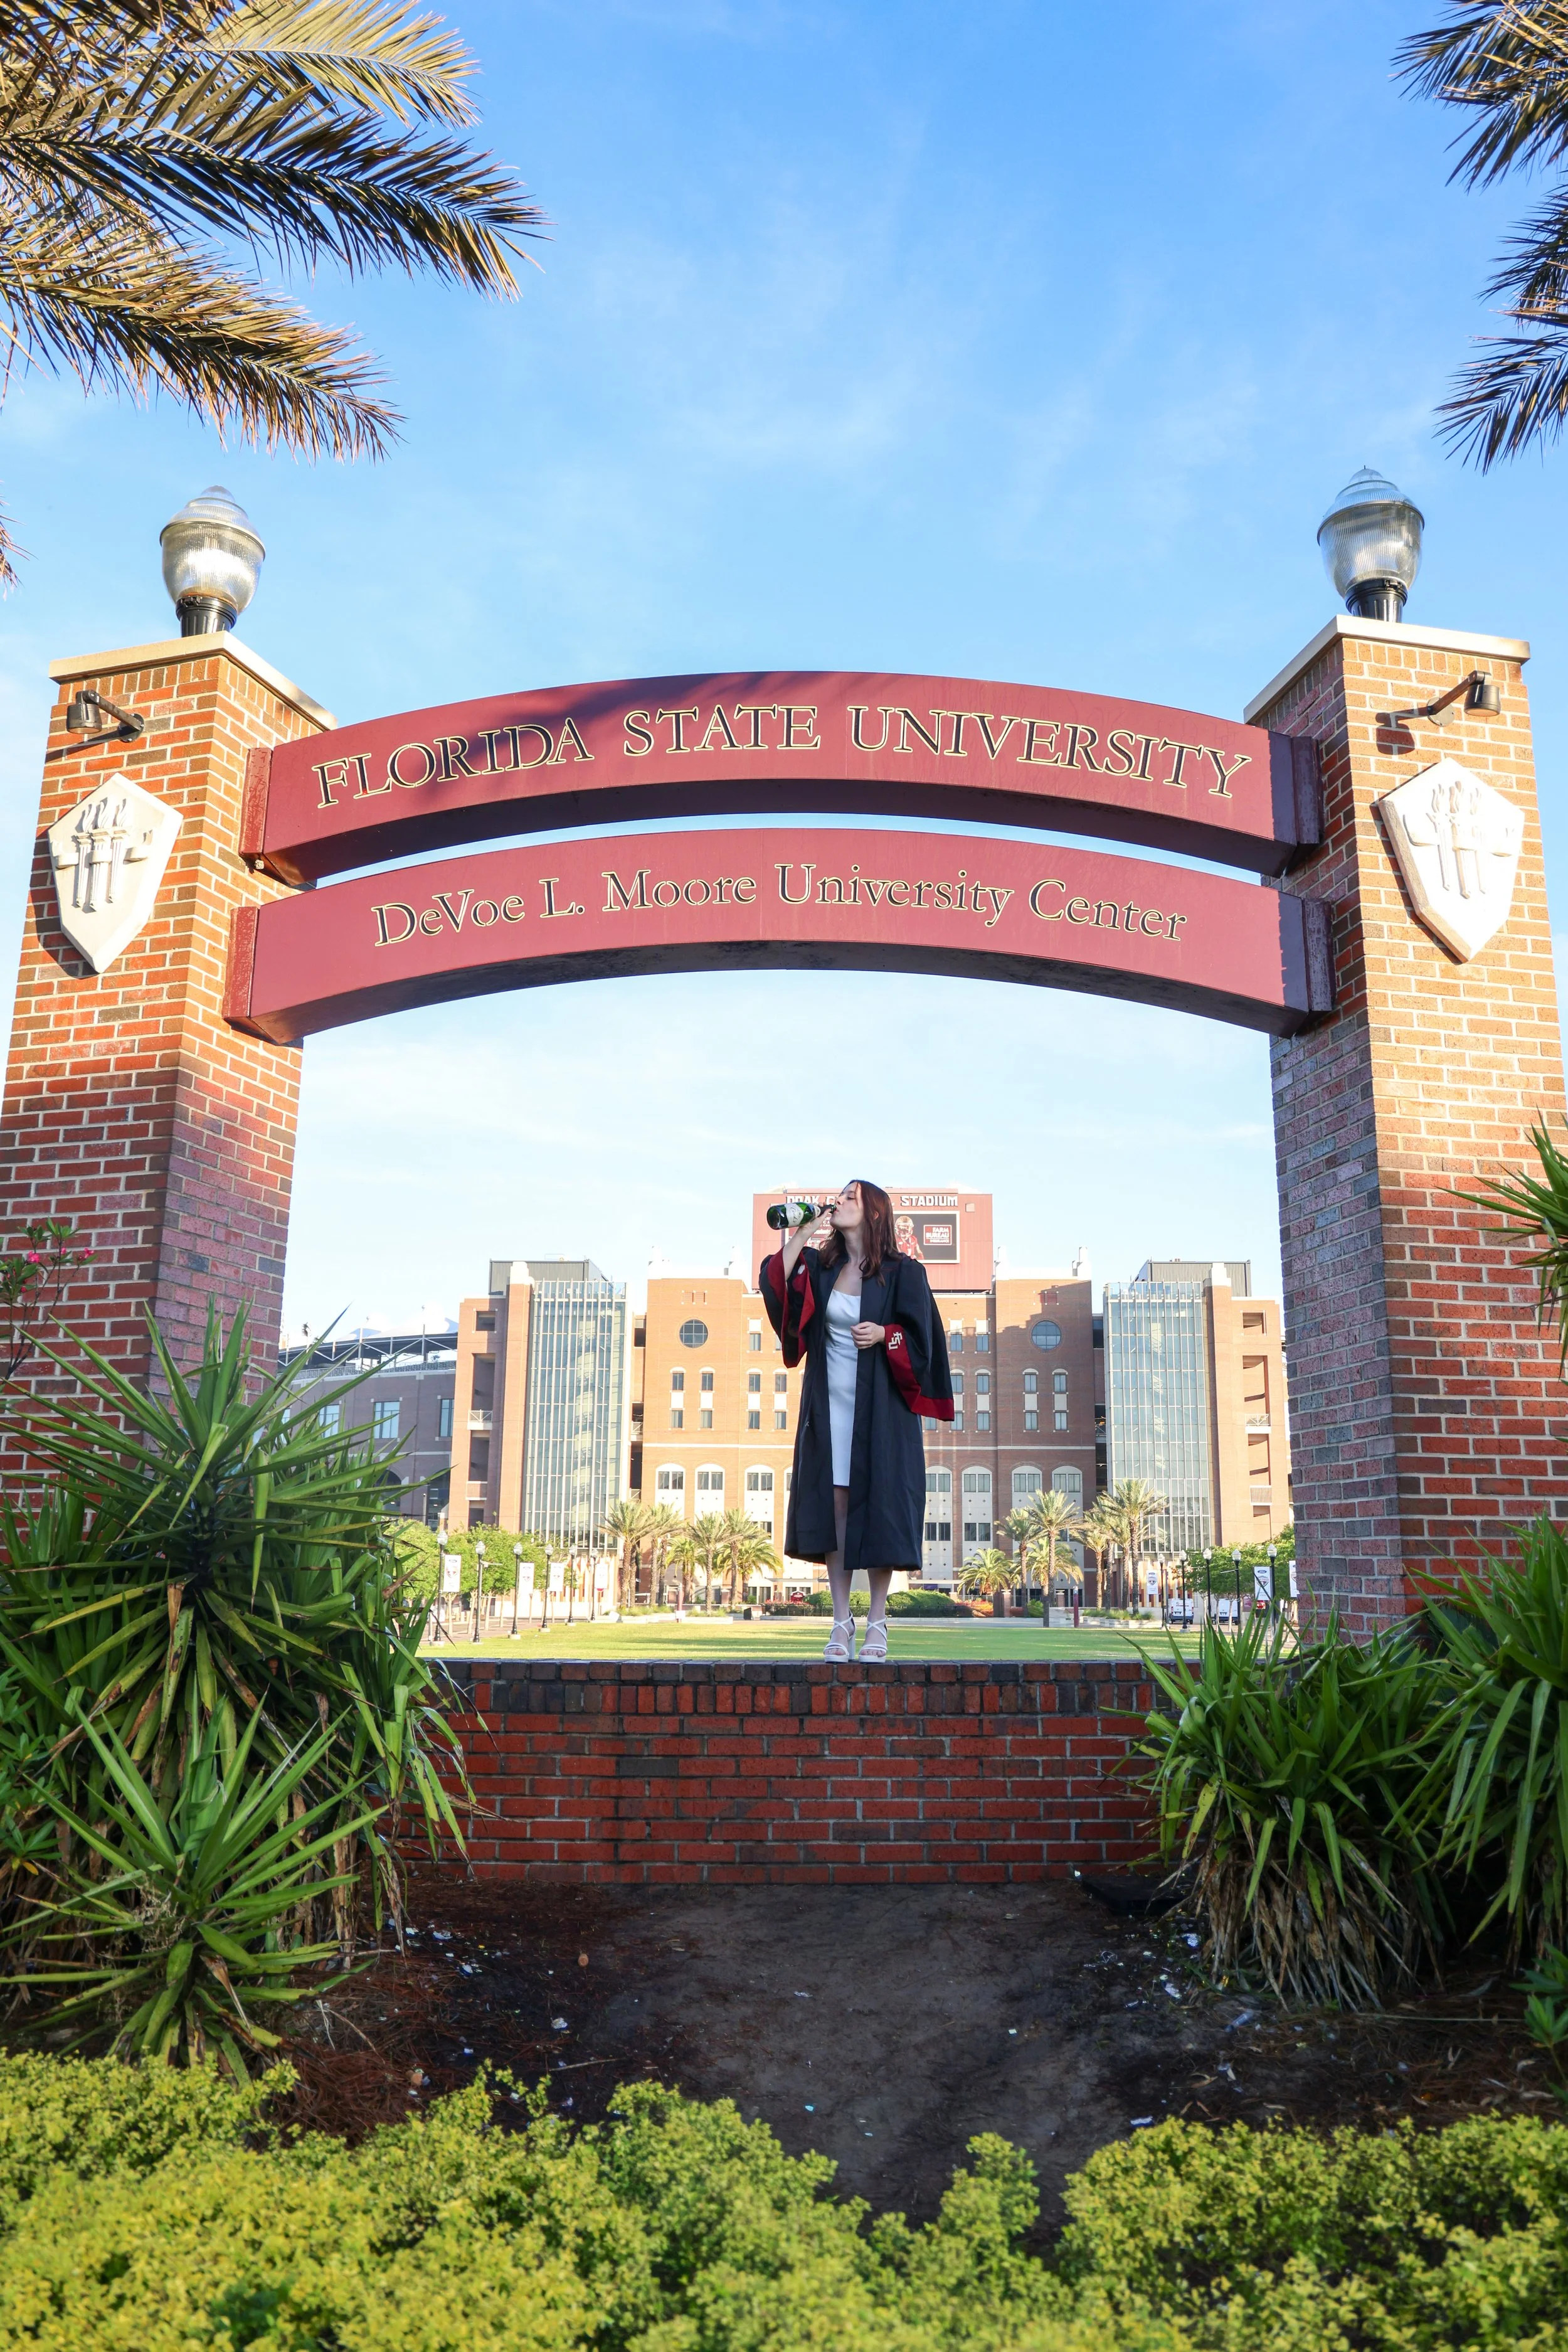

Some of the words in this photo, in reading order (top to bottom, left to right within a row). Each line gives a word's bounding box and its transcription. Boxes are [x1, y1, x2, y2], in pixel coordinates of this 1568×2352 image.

[312, 717, 595, 809] FLORIDA
[623, 704, 822, 757] STATE
[847, 705, 1253, 799] UNIVERSITY
[371, 889, 524, 947] DeVoe
[539, 878, 585, 919] L.
[601, 869, 757, 912] Moore
[774, 863, 1015, 927] University
[1029, 878, 1188, 941] Center
[900, 1195, 958, 1206] STADIUM
